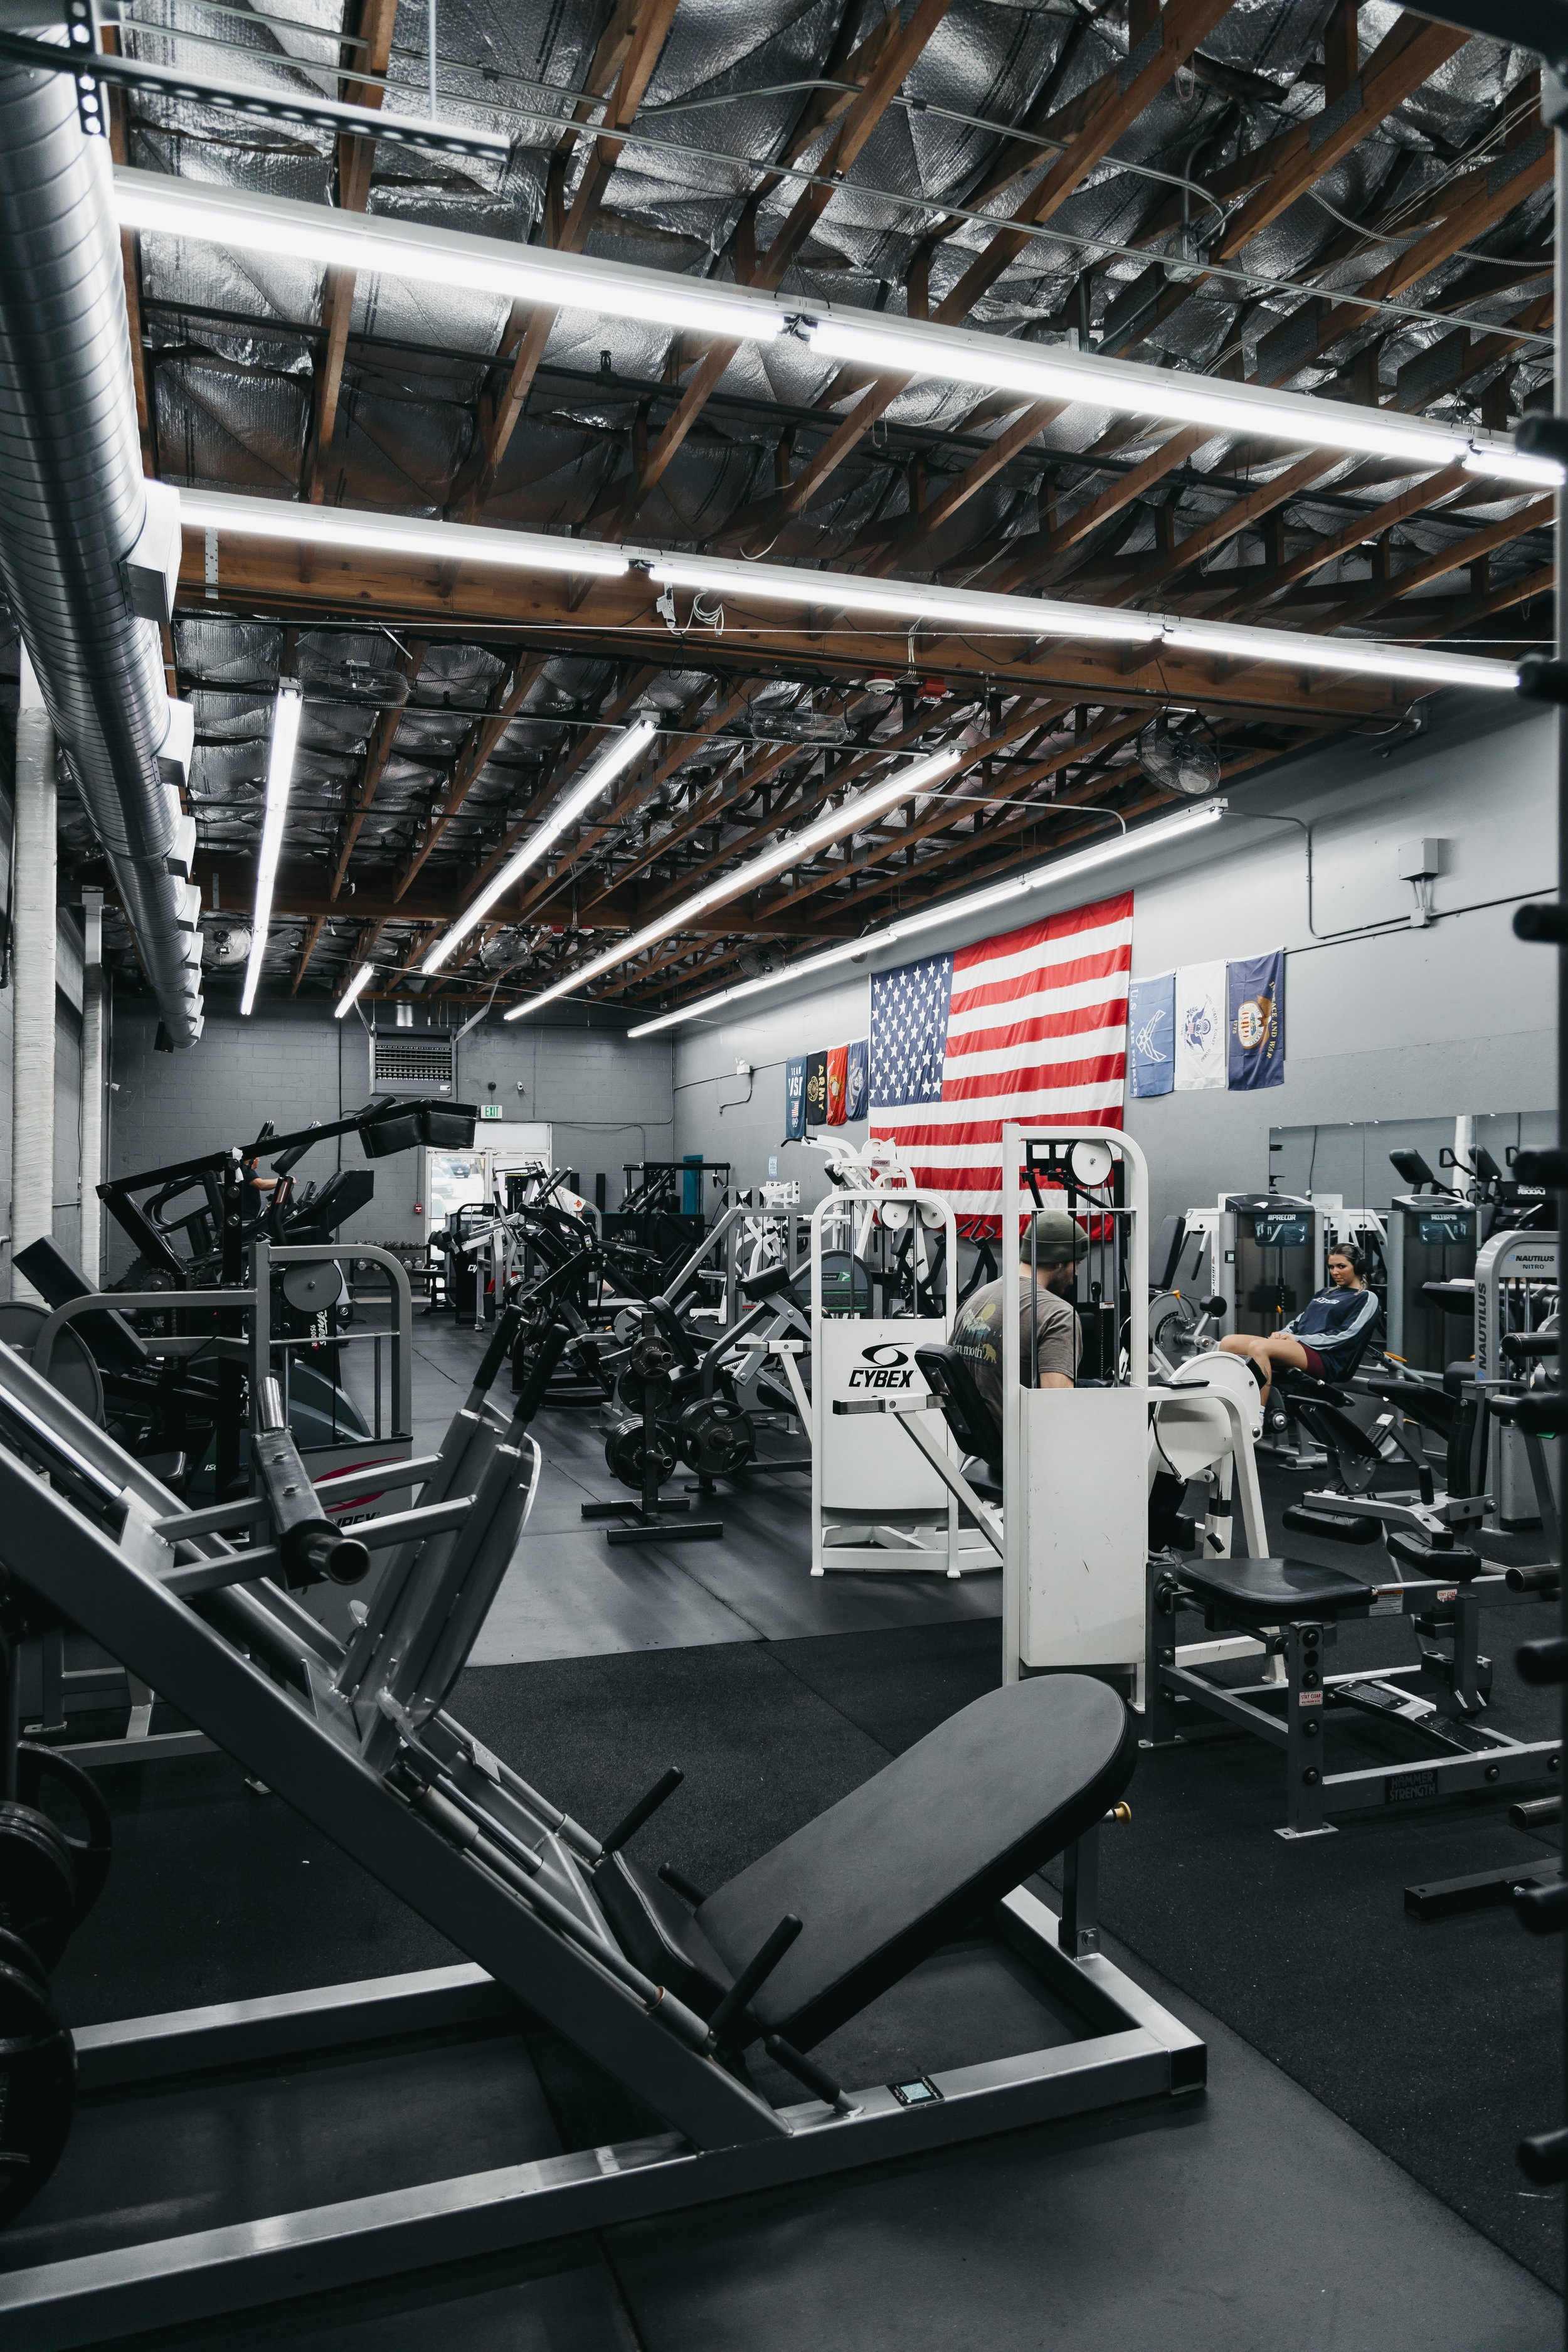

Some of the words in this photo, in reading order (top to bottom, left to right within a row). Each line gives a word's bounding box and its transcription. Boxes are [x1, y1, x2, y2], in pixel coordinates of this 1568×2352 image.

[1266, 1041, 1276, 1059] WAR
[485, 1106, 499, 1117] EXIT
[616, 1245, 637, 1253] Magnum
[1478, 1282, 1487, 1370] NAUTILUS
[848, 1370, 914, 1388] CYBEX
[1392, 1771, 1433, 1789] HAMMER
[1389, 1783, 1436, 1801] STRENGTH
